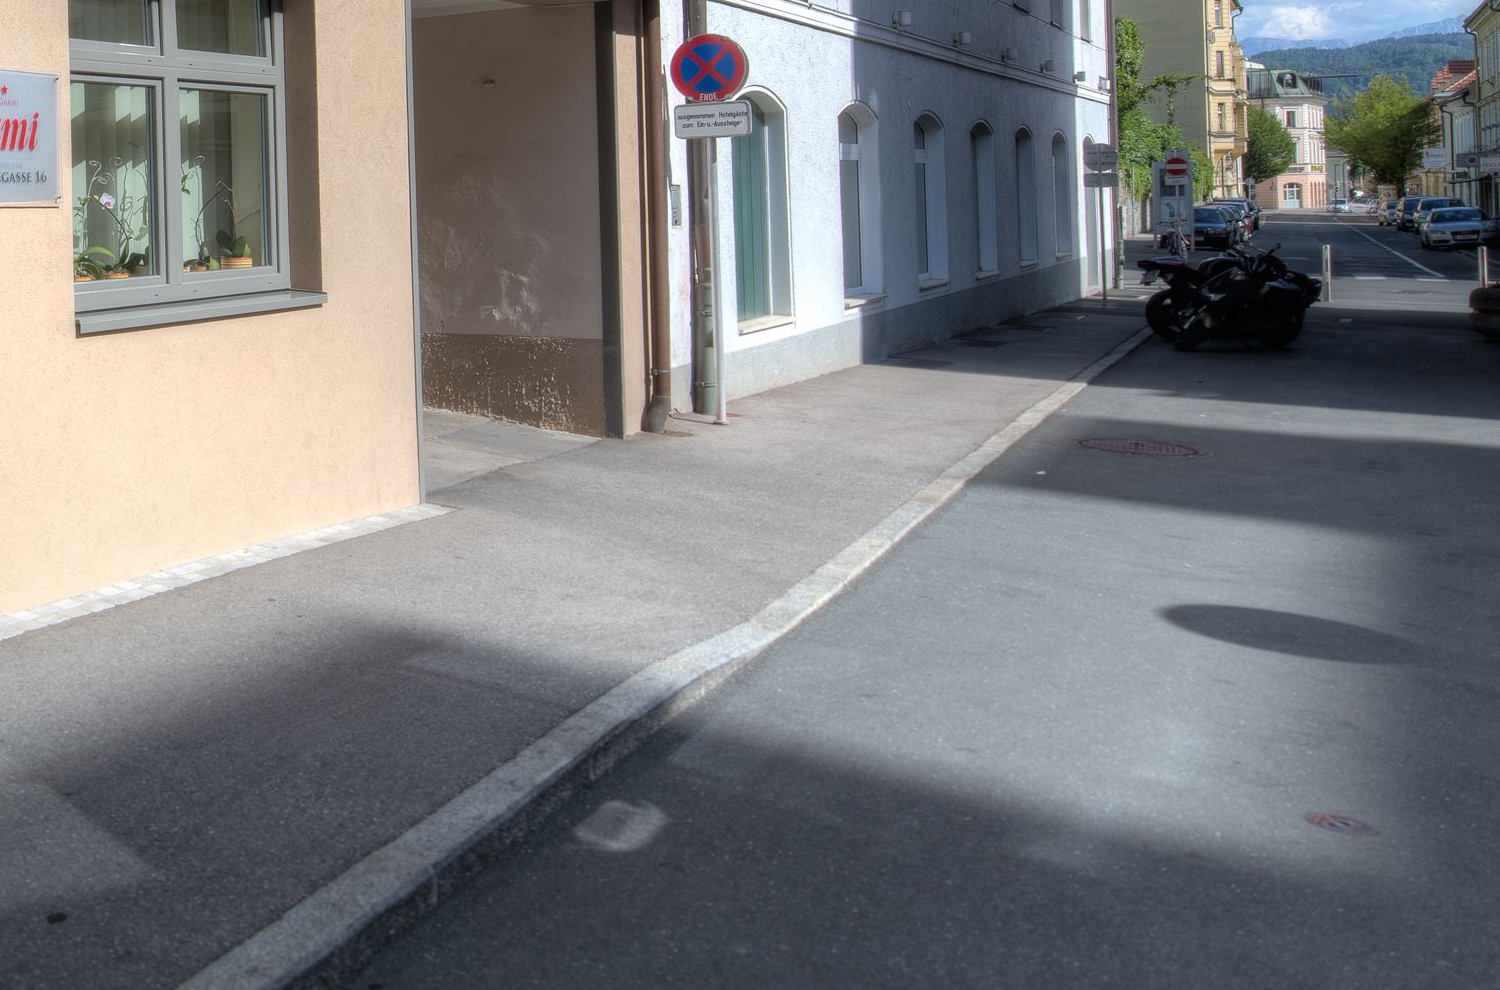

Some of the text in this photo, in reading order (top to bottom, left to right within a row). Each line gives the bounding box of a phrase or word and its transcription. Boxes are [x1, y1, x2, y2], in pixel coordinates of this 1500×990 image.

[699, 92, 718, 101] ENDE
[677, 110, 749, 122] ausgenommen Hotelgäste
[682, 121, 694, 129] zum
[35, 171, 47, 184] 16
